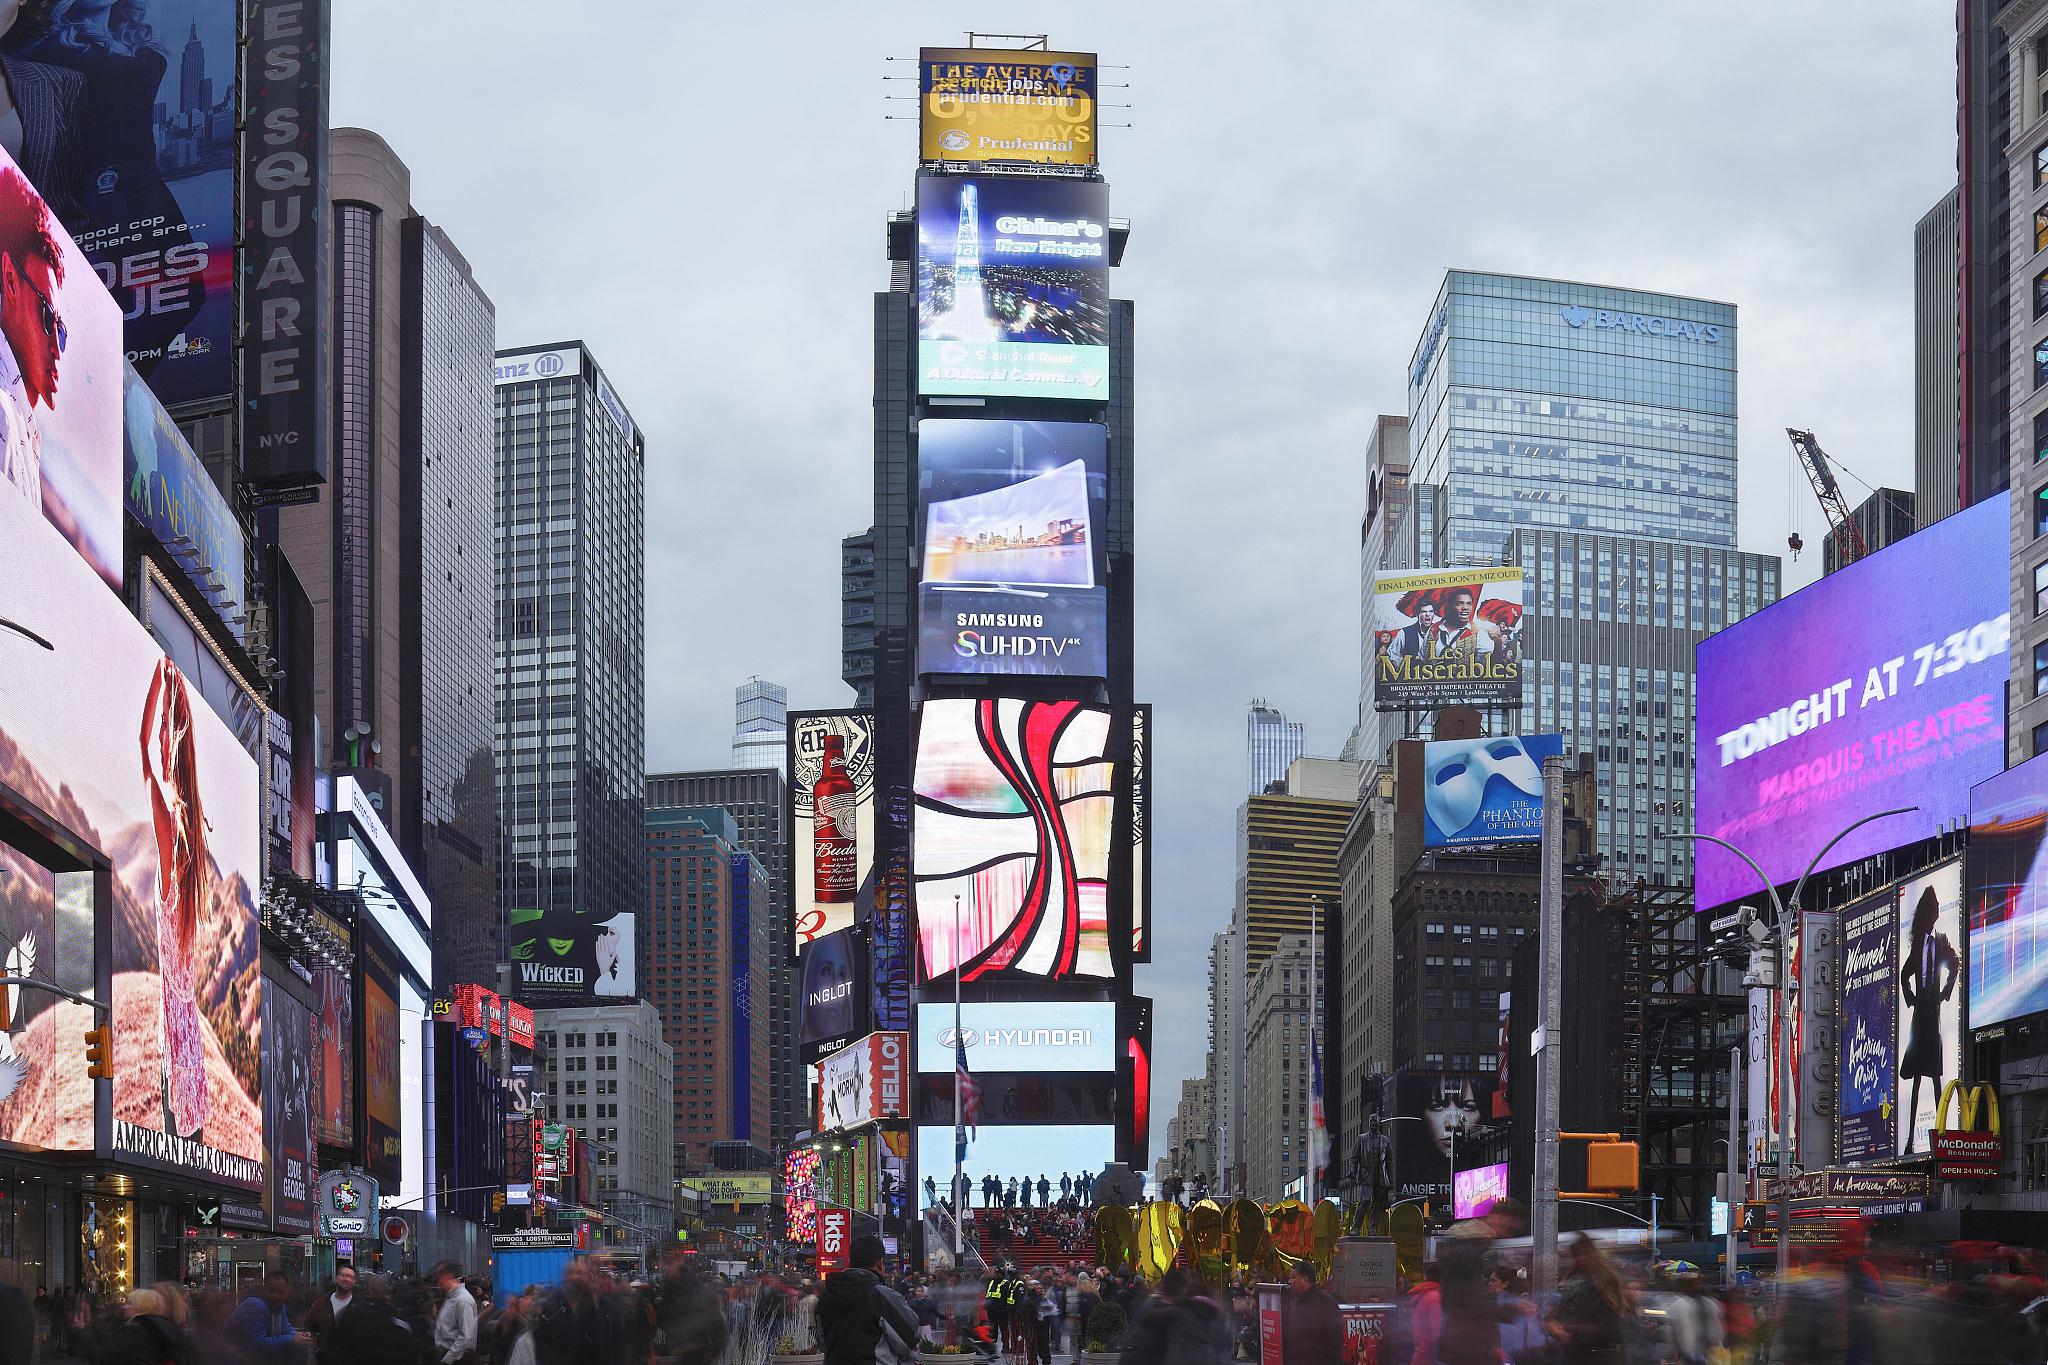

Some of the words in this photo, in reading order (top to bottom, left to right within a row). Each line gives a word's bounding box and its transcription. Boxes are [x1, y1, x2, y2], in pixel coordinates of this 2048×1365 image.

[978, 136, 1073, 152] Prudential
[73, 223, 119, 244] good
[129, 215, 165, 230] cop
[995, 216, 1103, 238] China's
[84, 232, 143, 252] there
[255, 107, 310, 395] SQUARE
[1595, 309, 1720, 344] BARCLAYS
[168, 352, 187, 360] NEW
[187, 347, 211, 357] YORK
[260, 431, 299, 449] NYC
[1378, 583, 1404, 591] FINAL
[1449, 573, 1478, 583] DON'T
[1480, 572, 1496, 580] MIZ
[1497, 570, 1520, 578] OUT!
[957, 612, 1044, 627] SAMSUNG
[1429, 640, 1463, 660] Les
[1380, 653, 1518, 682] Misérables
[1716, 678, 1852, 768] TONIGHT
[1859, 655, 1905, 709] AT
[1759, 742, 1864, 804] MARQUIS
[1872, 693, 1994, 763] THEATRE
[1511, 800, 1529, 808] THE
[1482, 807, 1544, 822] PHANTO
[1487, 822, 1500, 830] OF
[1502, 821, 1520, 829] THE
[1845, 931, 1892, 977] Winner!
[1861, 972, 1873, 987] TONY
[809, 981, 853, 1007] INGLOT
[1812, 928, 1832, 1114] PALACE
[818, 1038, 847, 1053] INGLOT
[984, 1028, 1092, 1046] HYUNDAI
[882, 1036, 900, 1114] HELLO!
[116, 1120, 179, 1164] AMERICAN
[1937, 1139, 2001, 1151] McDonald's
[287, 1158, 302, 1180] EDDIE
[283, 1178, 306, 1201] GEORGE
[1401, 1183, 1435, 1195] ANGIE
[1437, 1184, 1451, 1194] TR
[1846, 1175, 1885, 1195] American
[1887, 1178, 1907, 1194] Paris
[1860, 1205, 1882, 1215] CHANGE
[1883, 1203, 1904, 1214] MONEY
[1908, 1202, 1921, 1213] ATM
[514, 1227, 549, 1235] SnackBox
[824, 1212, 845, 1253] tkts
